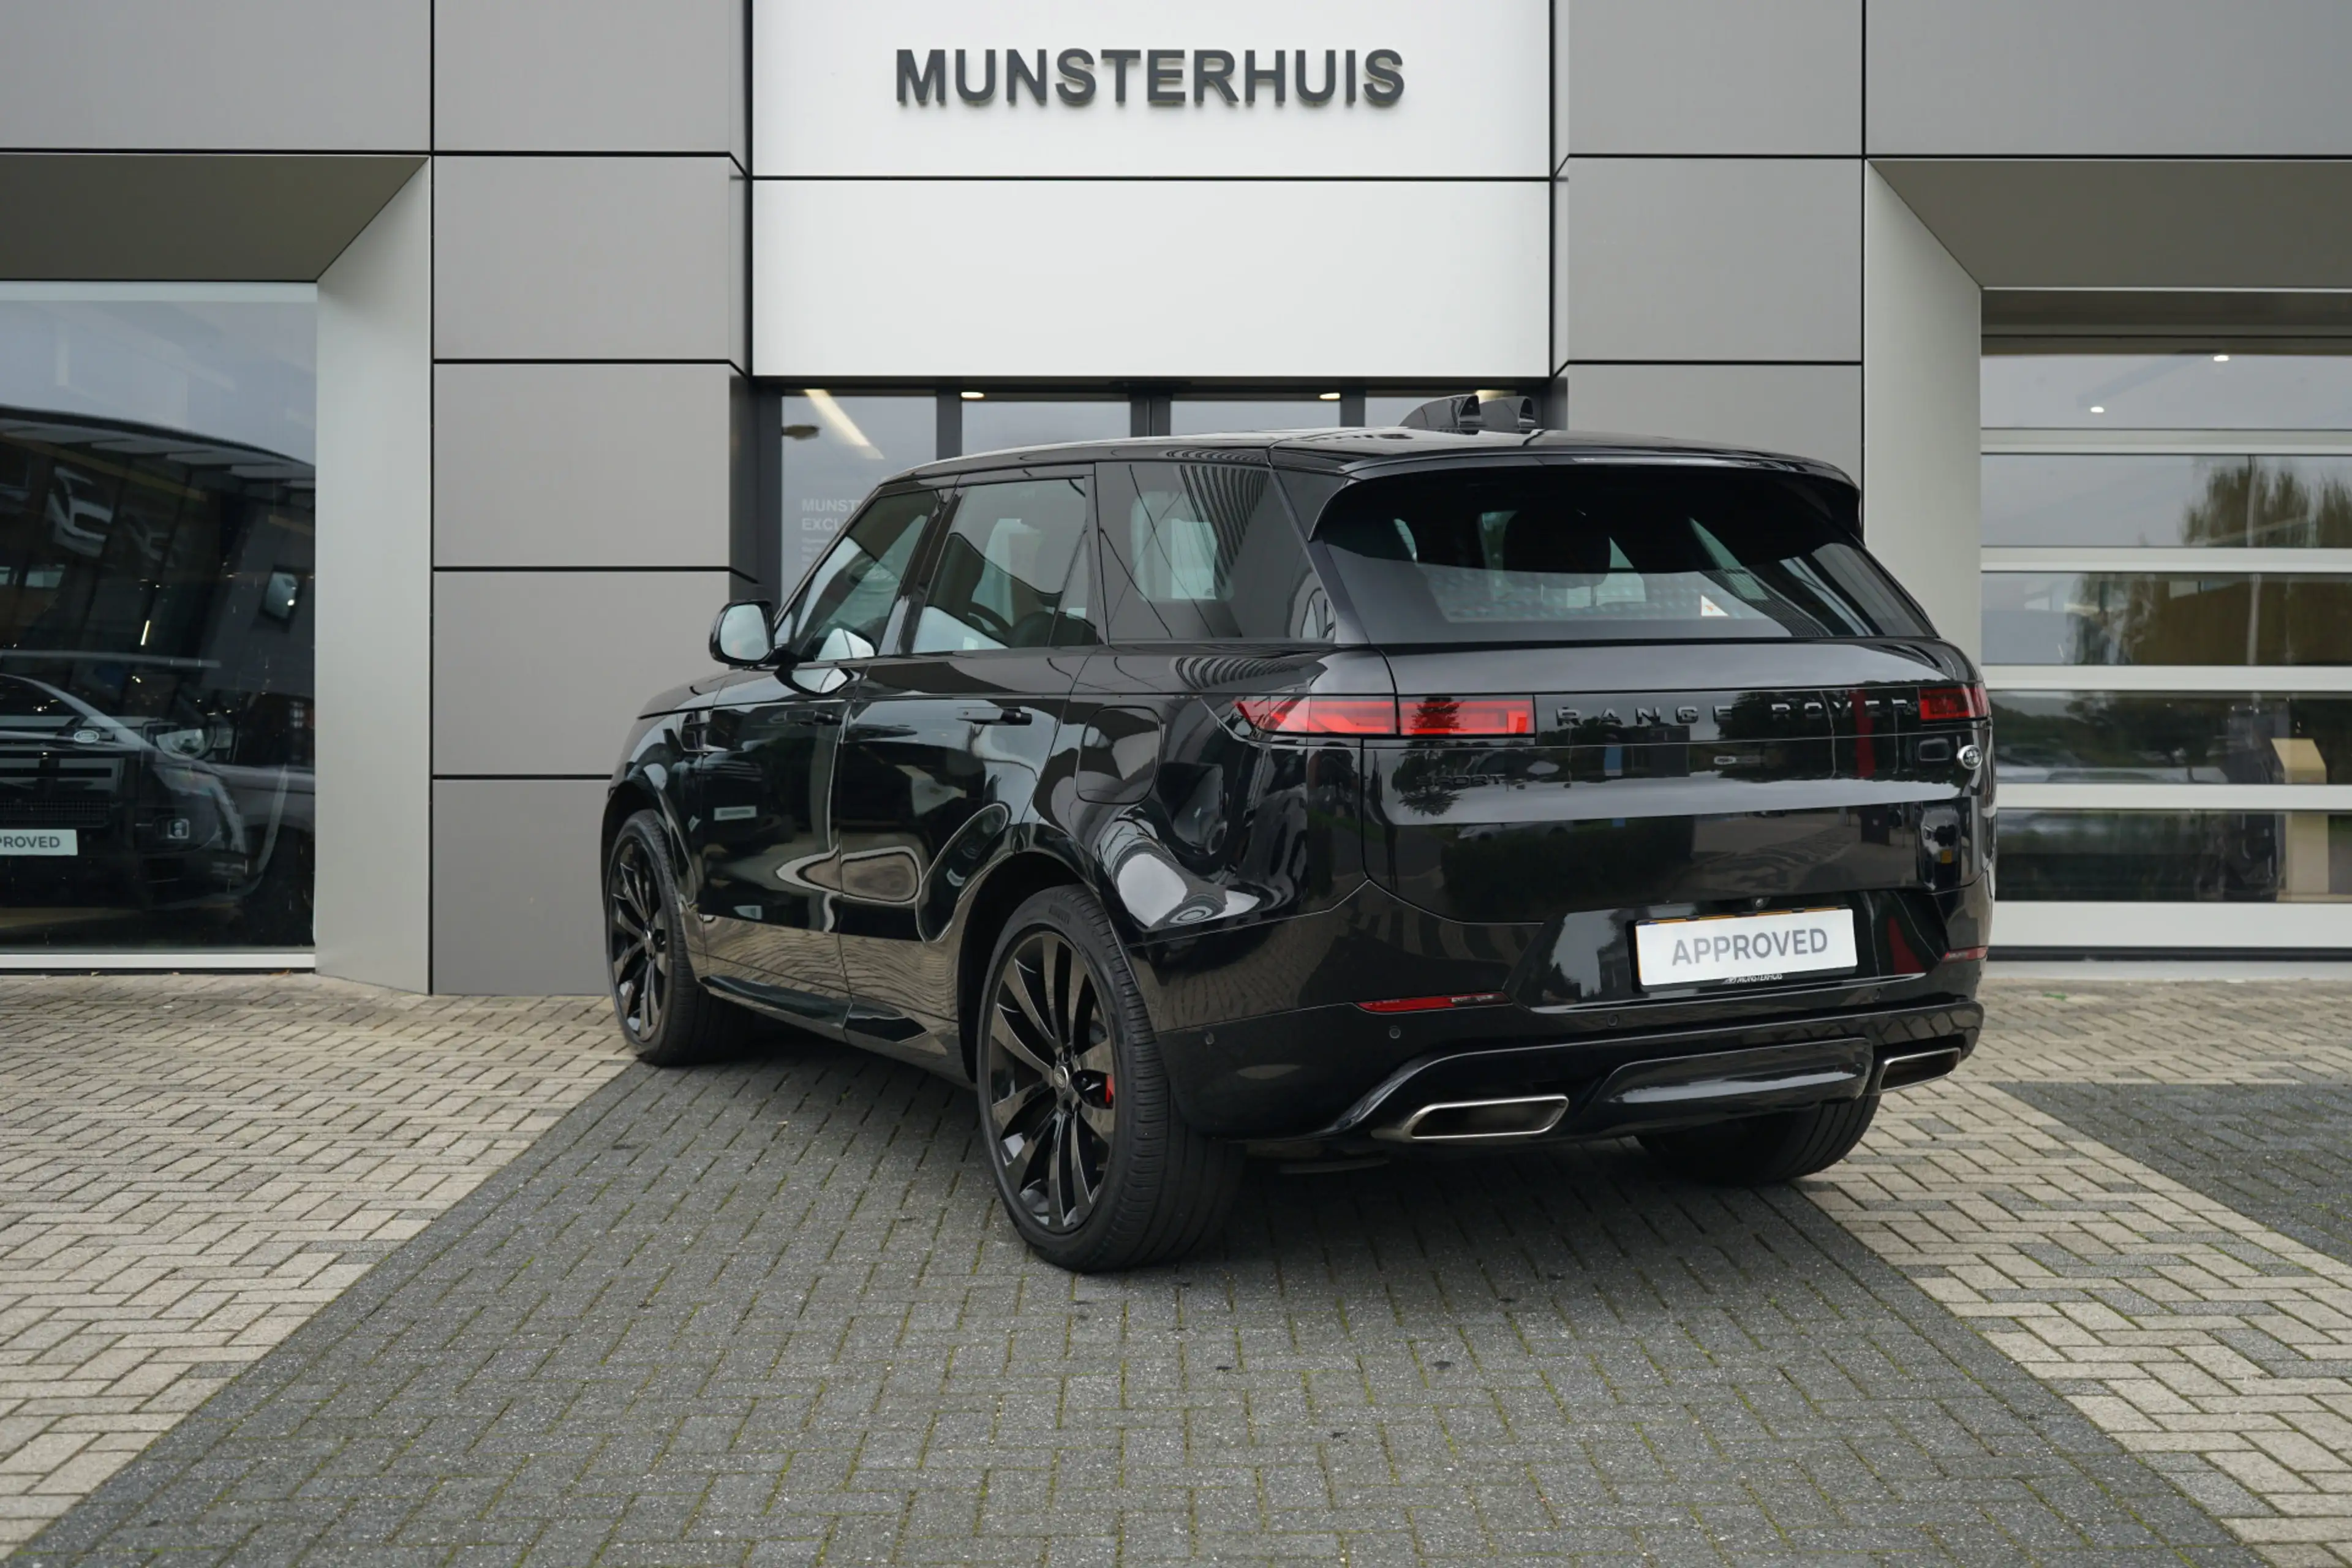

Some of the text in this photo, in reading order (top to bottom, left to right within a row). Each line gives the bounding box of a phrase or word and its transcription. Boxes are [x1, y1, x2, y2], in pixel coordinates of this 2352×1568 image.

[896, 48, 1405, 104] MUNSTERHUIS
[801, 499, 864, 512] MUNST
[801, 518, 848, 531] EXCL
[1556, 704, 1733, 727] RANGE
[0, 835, 60, 848] ROVED
[1672, 928, 1828, 966] APPROVED
